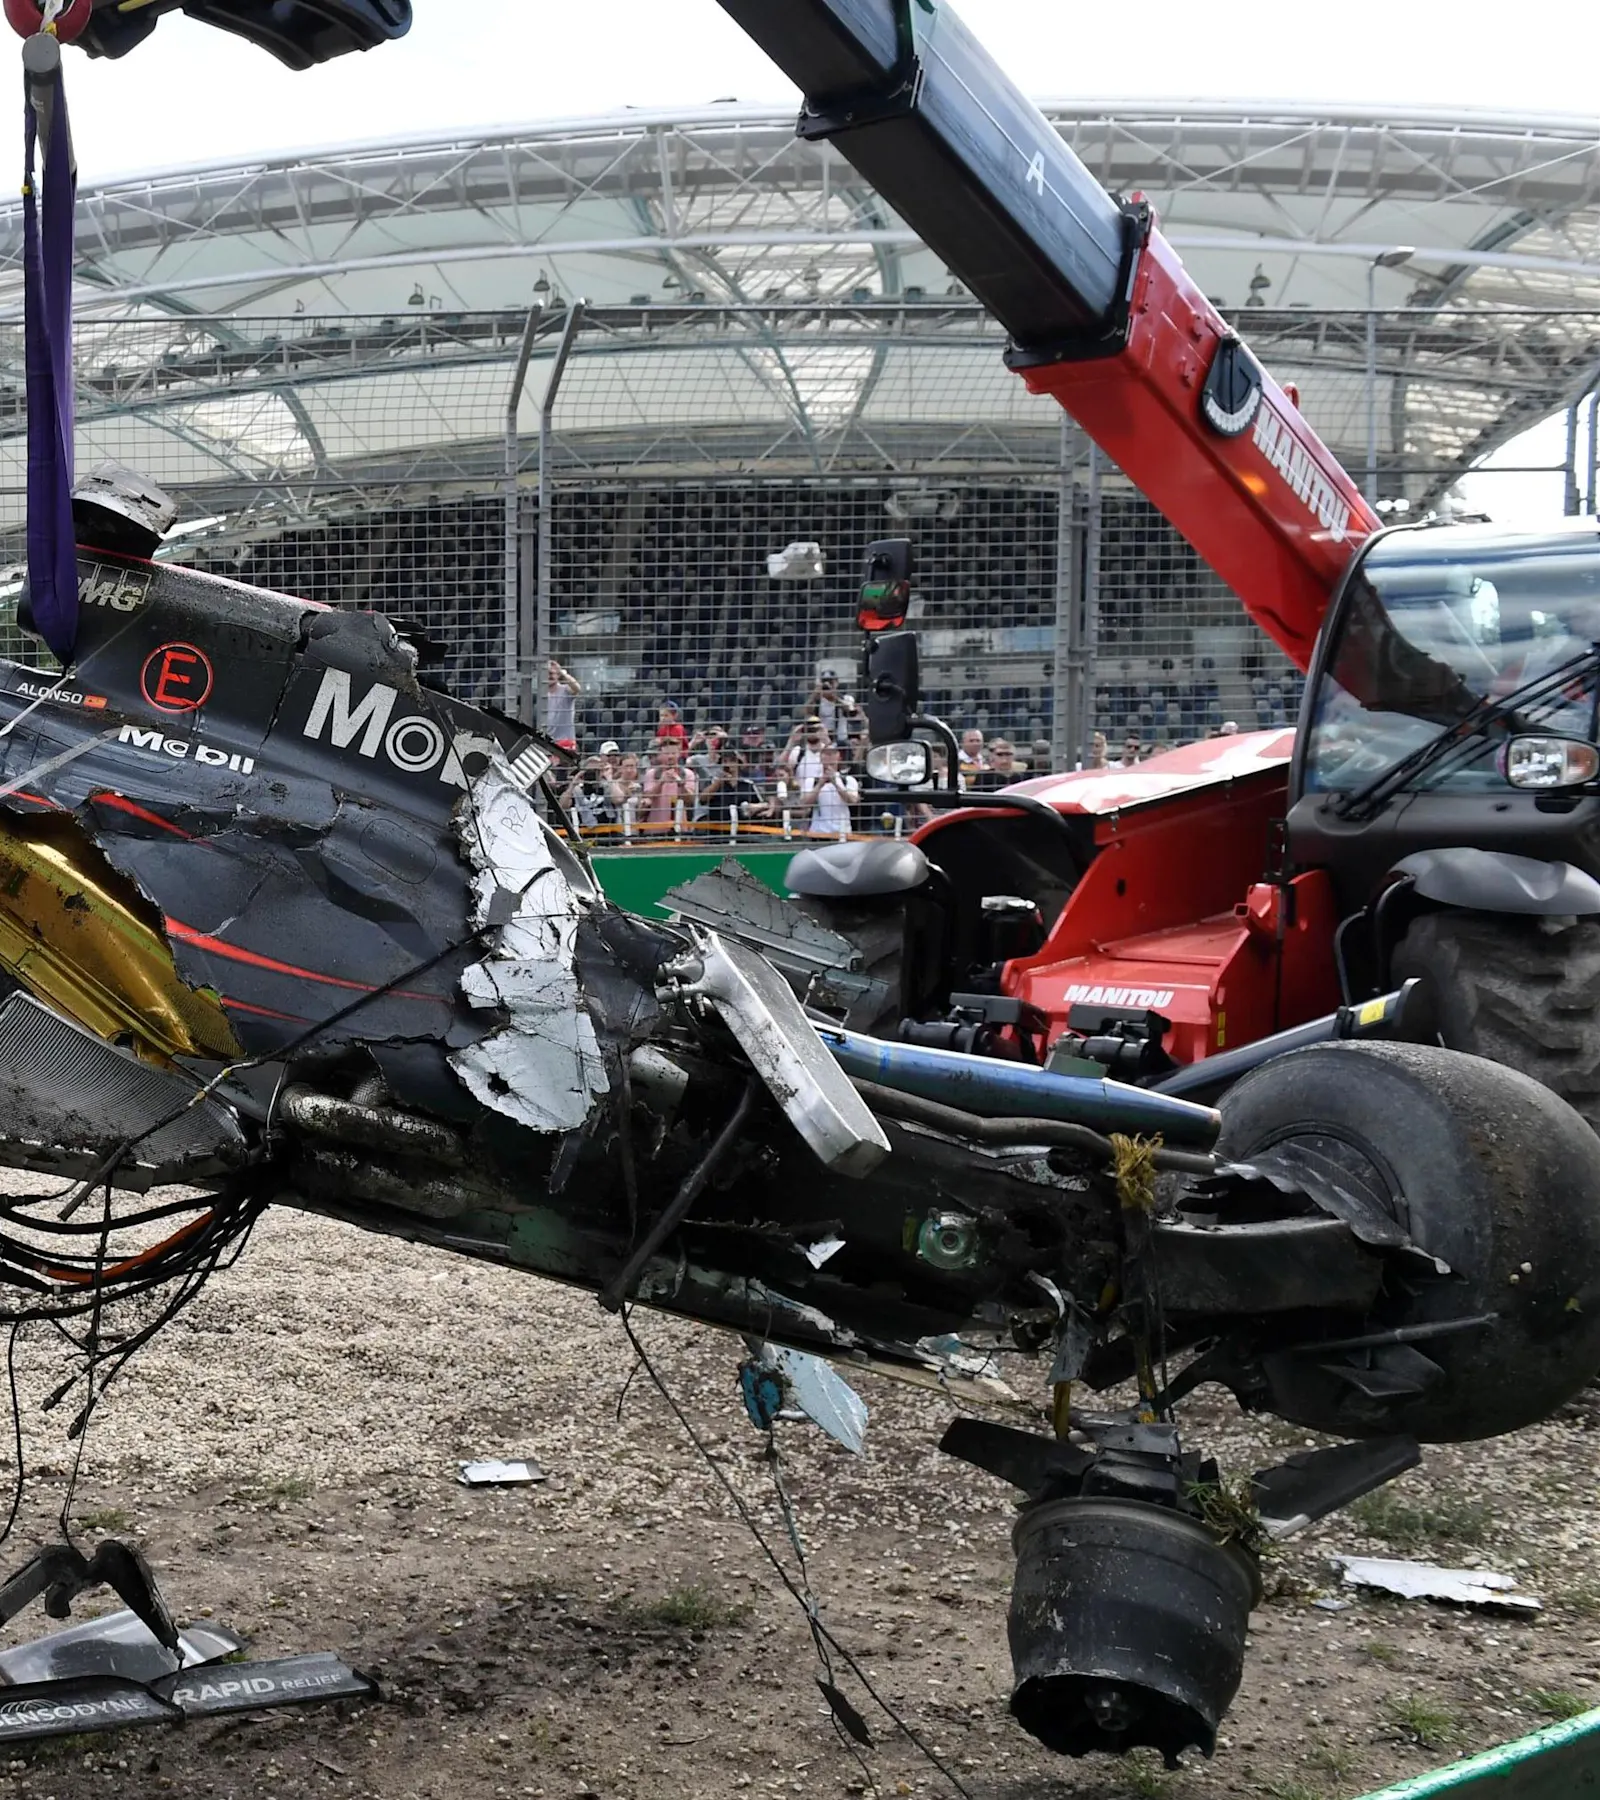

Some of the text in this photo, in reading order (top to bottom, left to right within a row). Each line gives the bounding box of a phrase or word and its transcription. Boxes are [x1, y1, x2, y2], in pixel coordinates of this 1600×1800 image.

[1025, 150, 1045, 196] A
[1252, 402, 1350, 543] MANITOU
[16, 682, 84, 705] ALONSO
[155, 650, 199, 710] E
[1063, 984, 1175, 1009] MANITOU
[172, 1677, 275, 1705] RAPID
[282, 1674, 342, 1690] RELIEF
